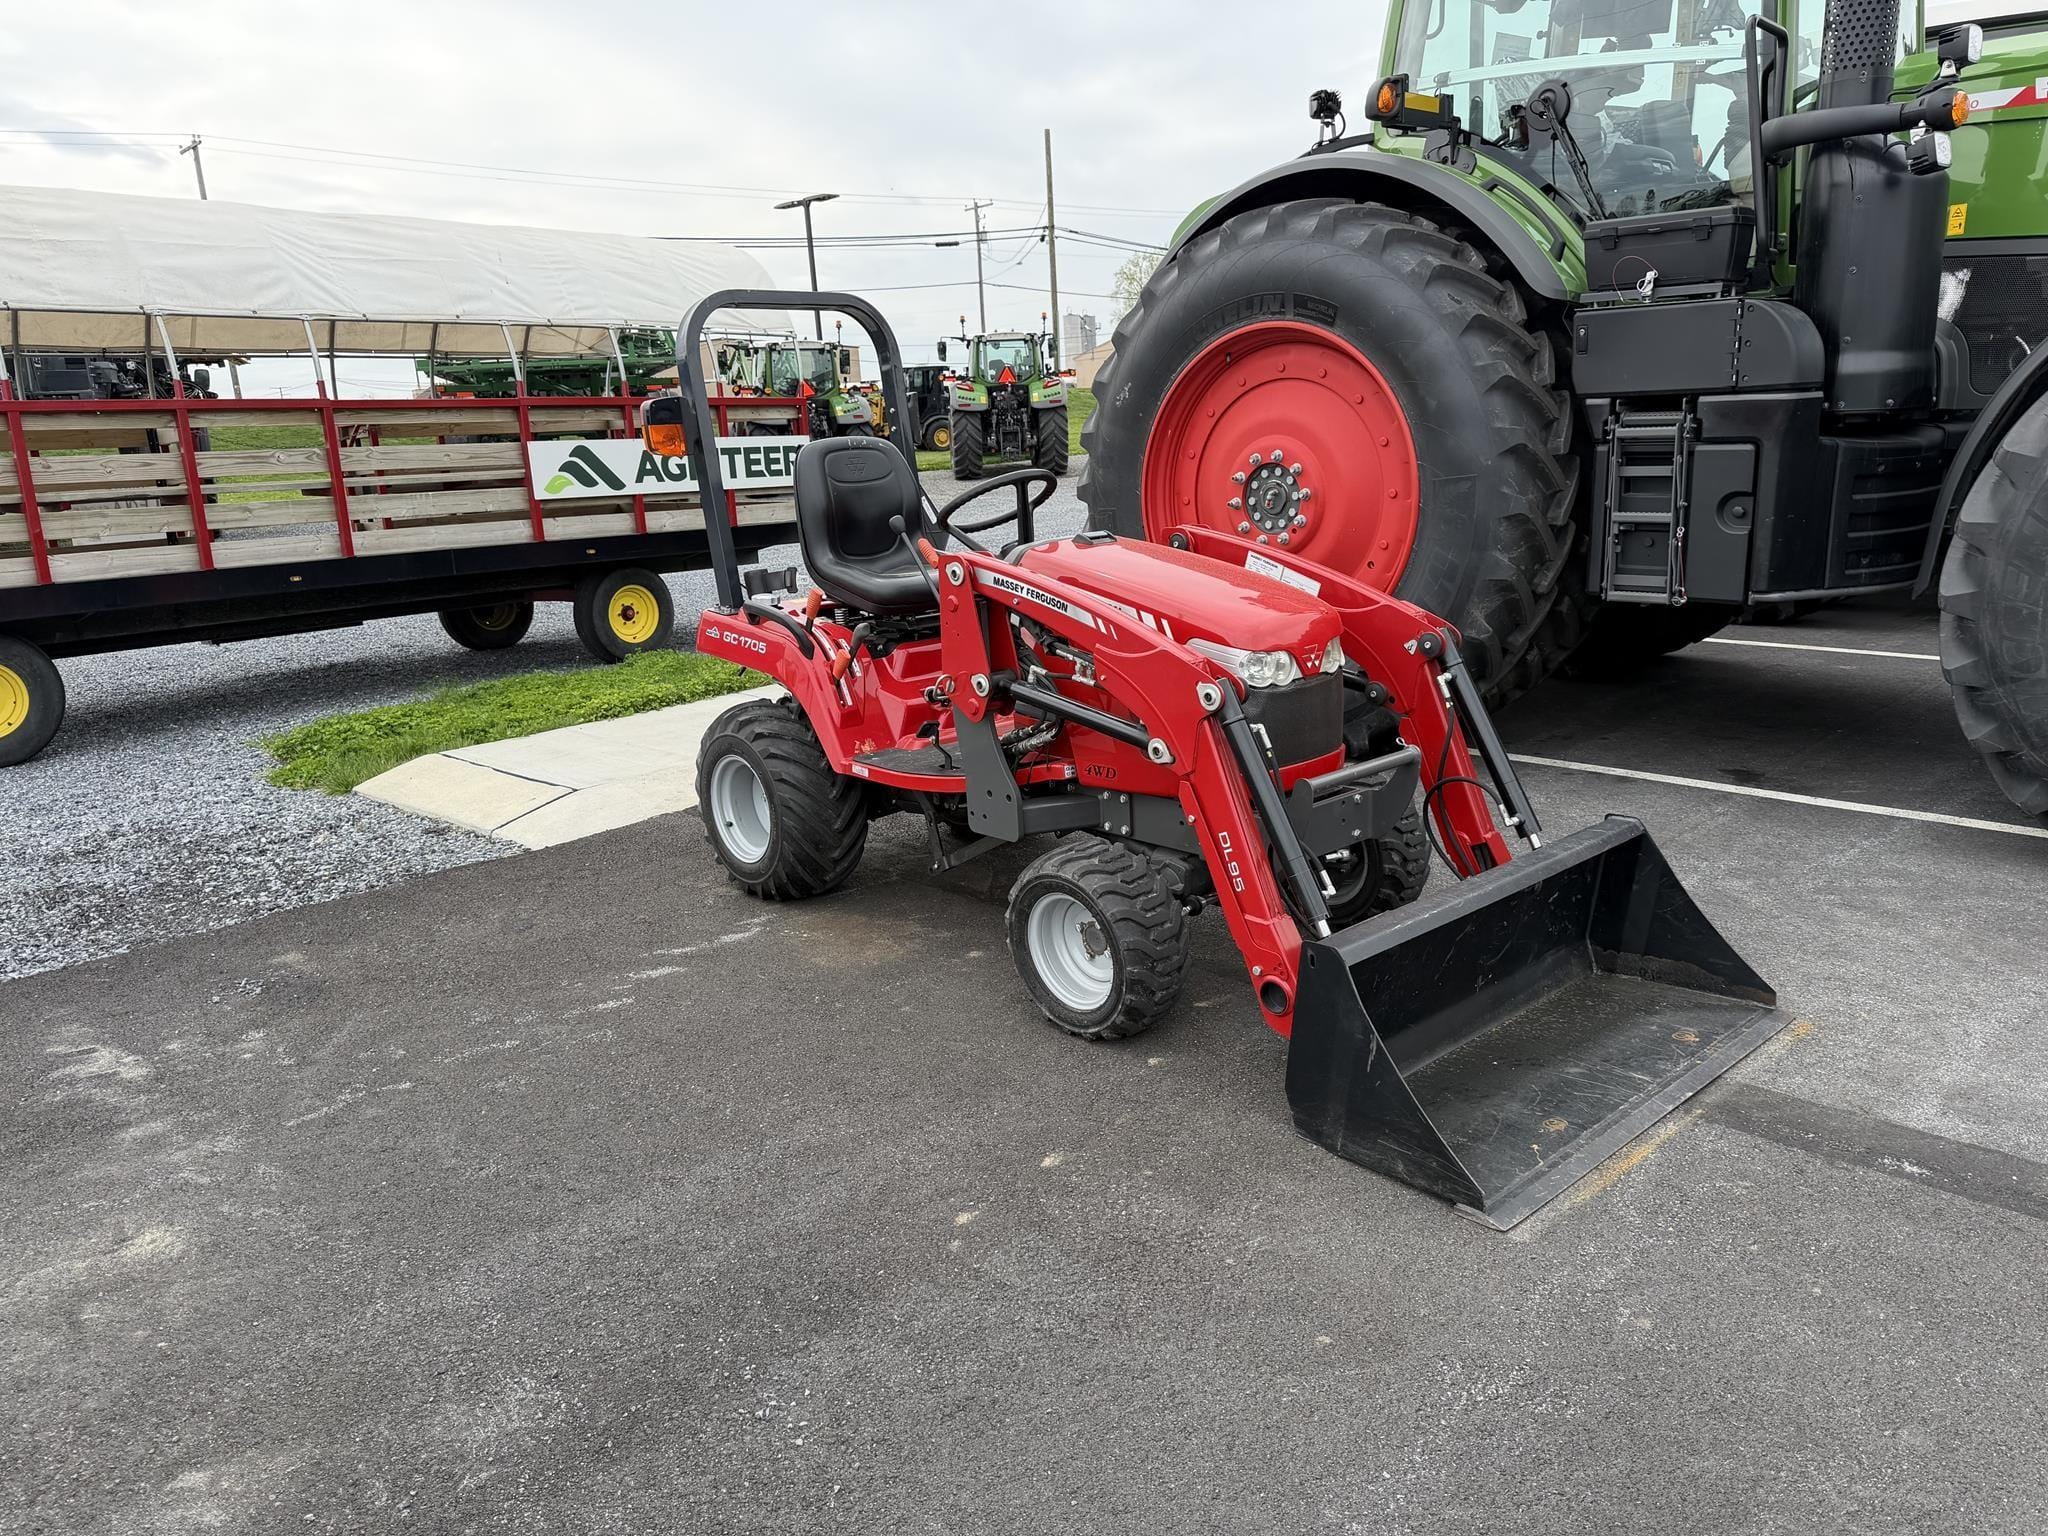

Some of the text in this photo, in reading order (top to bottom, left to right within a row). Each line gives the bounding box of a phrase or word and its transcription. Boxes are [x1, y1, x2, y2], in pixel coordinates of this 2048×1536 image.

[635, 446, 798, 483] AGTEER
[993, 576, 1069, 613] MASSEY FERGUSON
[722, 631, 767, 654] GC1705
[1084, 760, 1117, 779] 4WD
[1218, 831, 1246, 892] DL95
